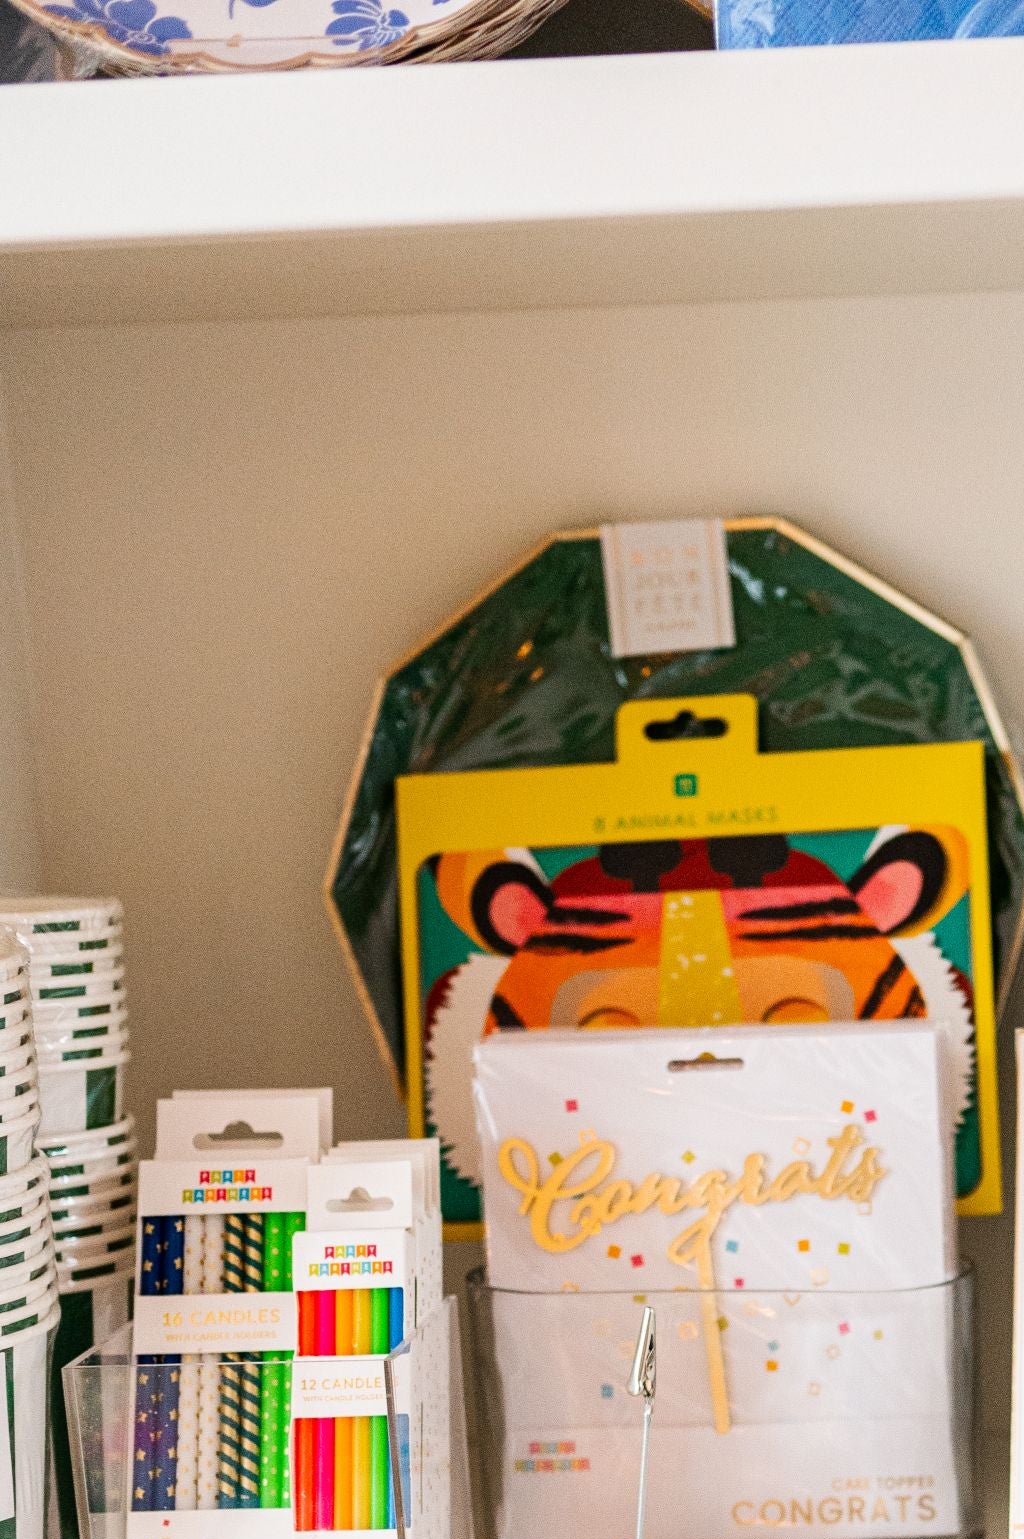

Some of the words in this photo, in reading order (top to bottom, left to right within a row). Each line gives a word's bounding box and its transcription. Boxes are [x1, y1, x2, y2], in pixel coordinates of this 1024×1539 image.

[615, 813, 698, 831] ANIMAL
[707, 804, 778, 825] MASKS
[200, 1170, 255, 1183] PARTY
[183, 1188, 271, 1202] PARTNERS
[499, 1123, 886, 1265] Congrats
[325, 1245, 376, 1258] PARTY
[309, 1262, 391, 1275] PARTNERS
[163, 1312, 183, 1327] 16
[189, 1308, 280, 1327] CANDLES
[165, 1333, 190, 1342] WITH
[192, 1332, 229, 1341] CANDLE
[301, 1379, 317, 1391] 12
[731, 1493, 937, 1526] CONGRATS
